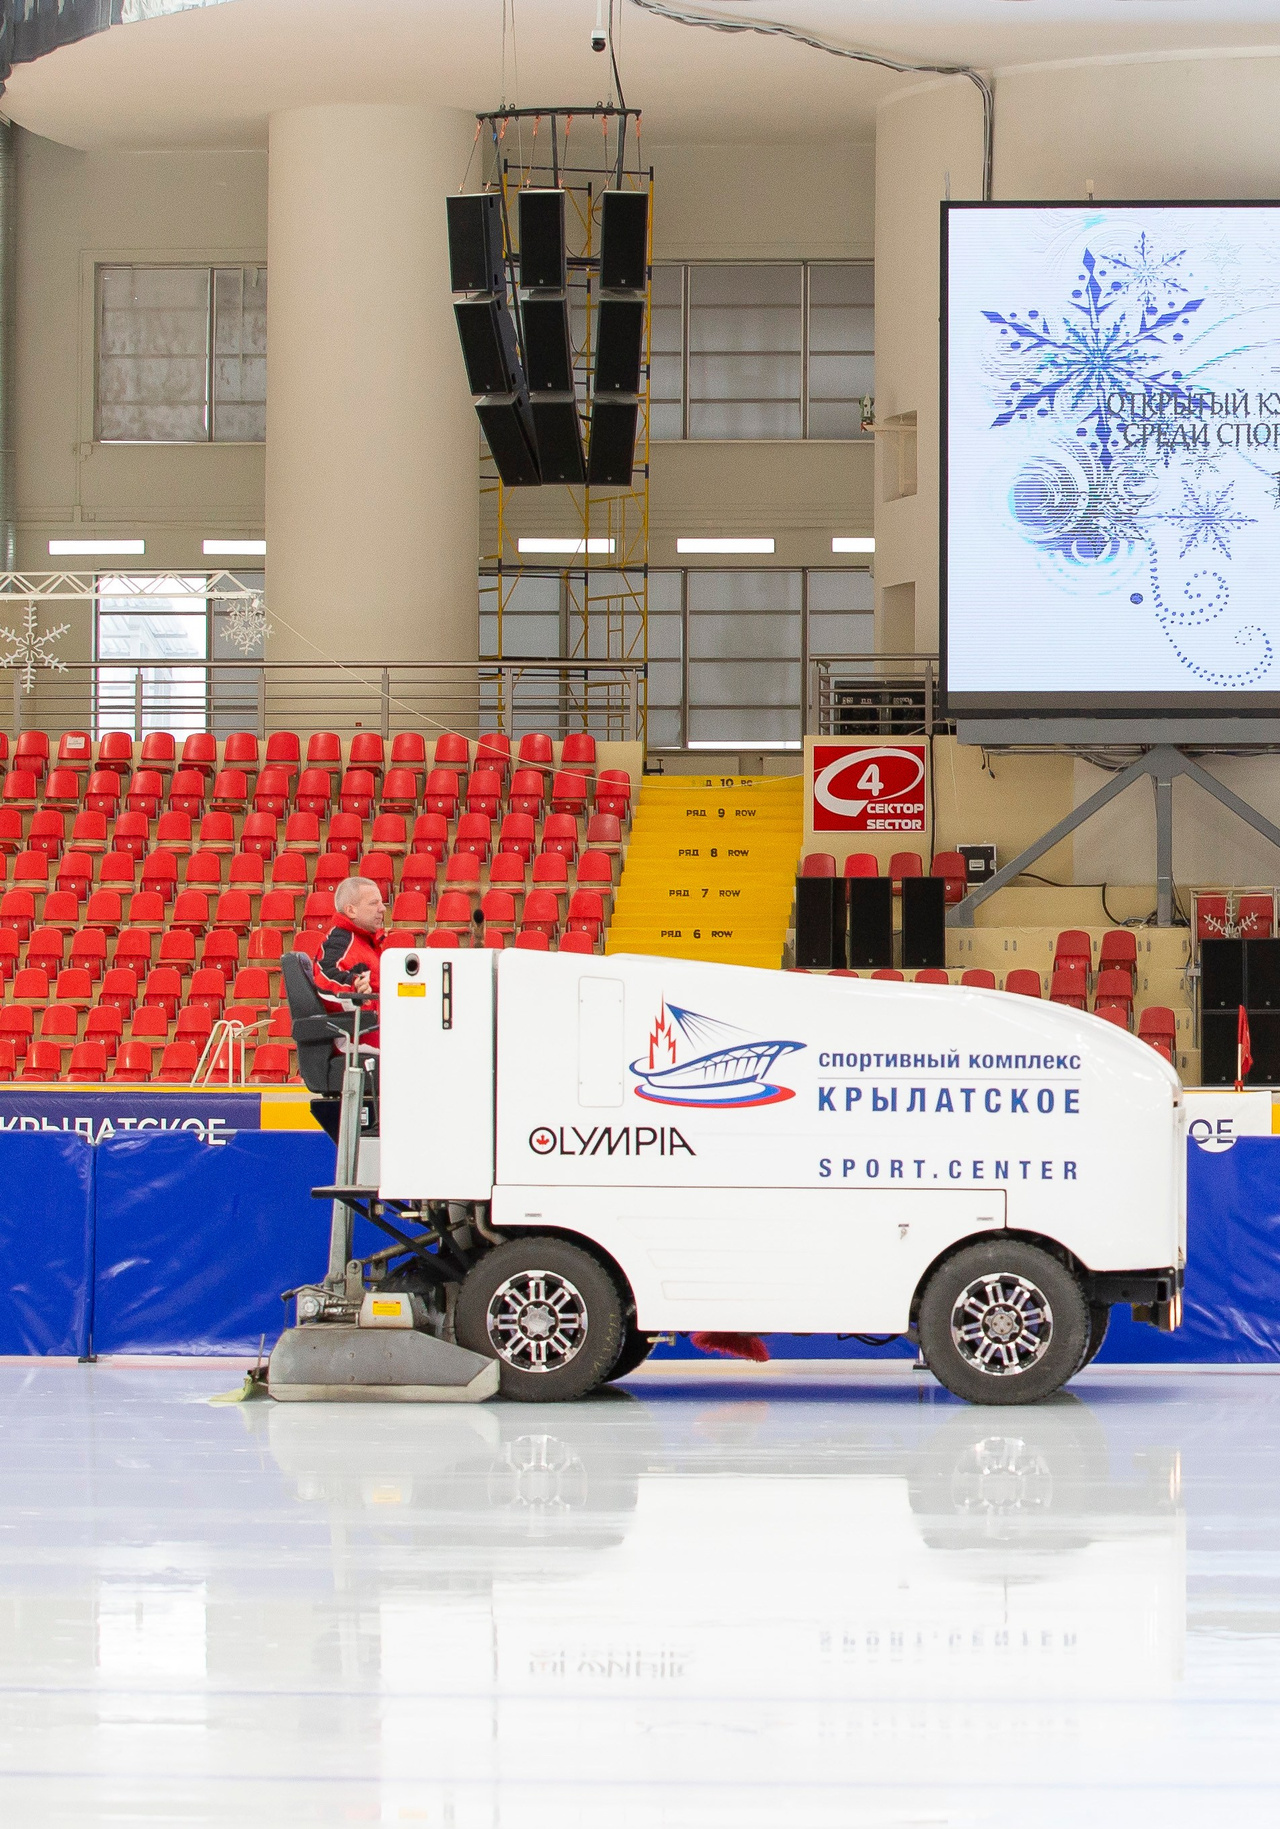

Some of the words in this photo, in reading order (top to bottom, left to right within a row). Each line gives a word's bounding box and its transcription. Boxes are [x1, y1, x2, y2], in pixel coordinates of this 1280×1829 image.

[1107, 389, 1250, 417] ОТКРЫТЫЙ
[1124, 423, 1208, 450] СРЕДИ
[856, 763, 884, 796] 4
[686, 809, 707, 817] РЯД
[717, 807, 725, 818] 9
[735, 809, 757, 817] ROW
[866, 803, 924, 814] СЕКТОР
[866, 819, 922, 830] SECTOR
[678, 849, 700, 857] РЯД
[710, 848, 718, 858] 8
[728, 849, 750, 857] ROW
[669, 889, 690, 897] РЯД
[701, 887, 709, 898] 7
[719, 889, 741, 897] ROW
[661, 930, 682, 938] РЯД
[693, 929, 701, 939] 6
[711, 930, 733, 938] ROW
[818, 1048, 961, 1072] спортивный
[968, 1052, 1082, 1070] комплекс
[818, 1086, 1080, 1114] КРЫЛАТСКОЕ
[528, 1126, 697, 1156] OLYMPIA
[818, 1158, 1078, 1180] SPORT.CENTER
